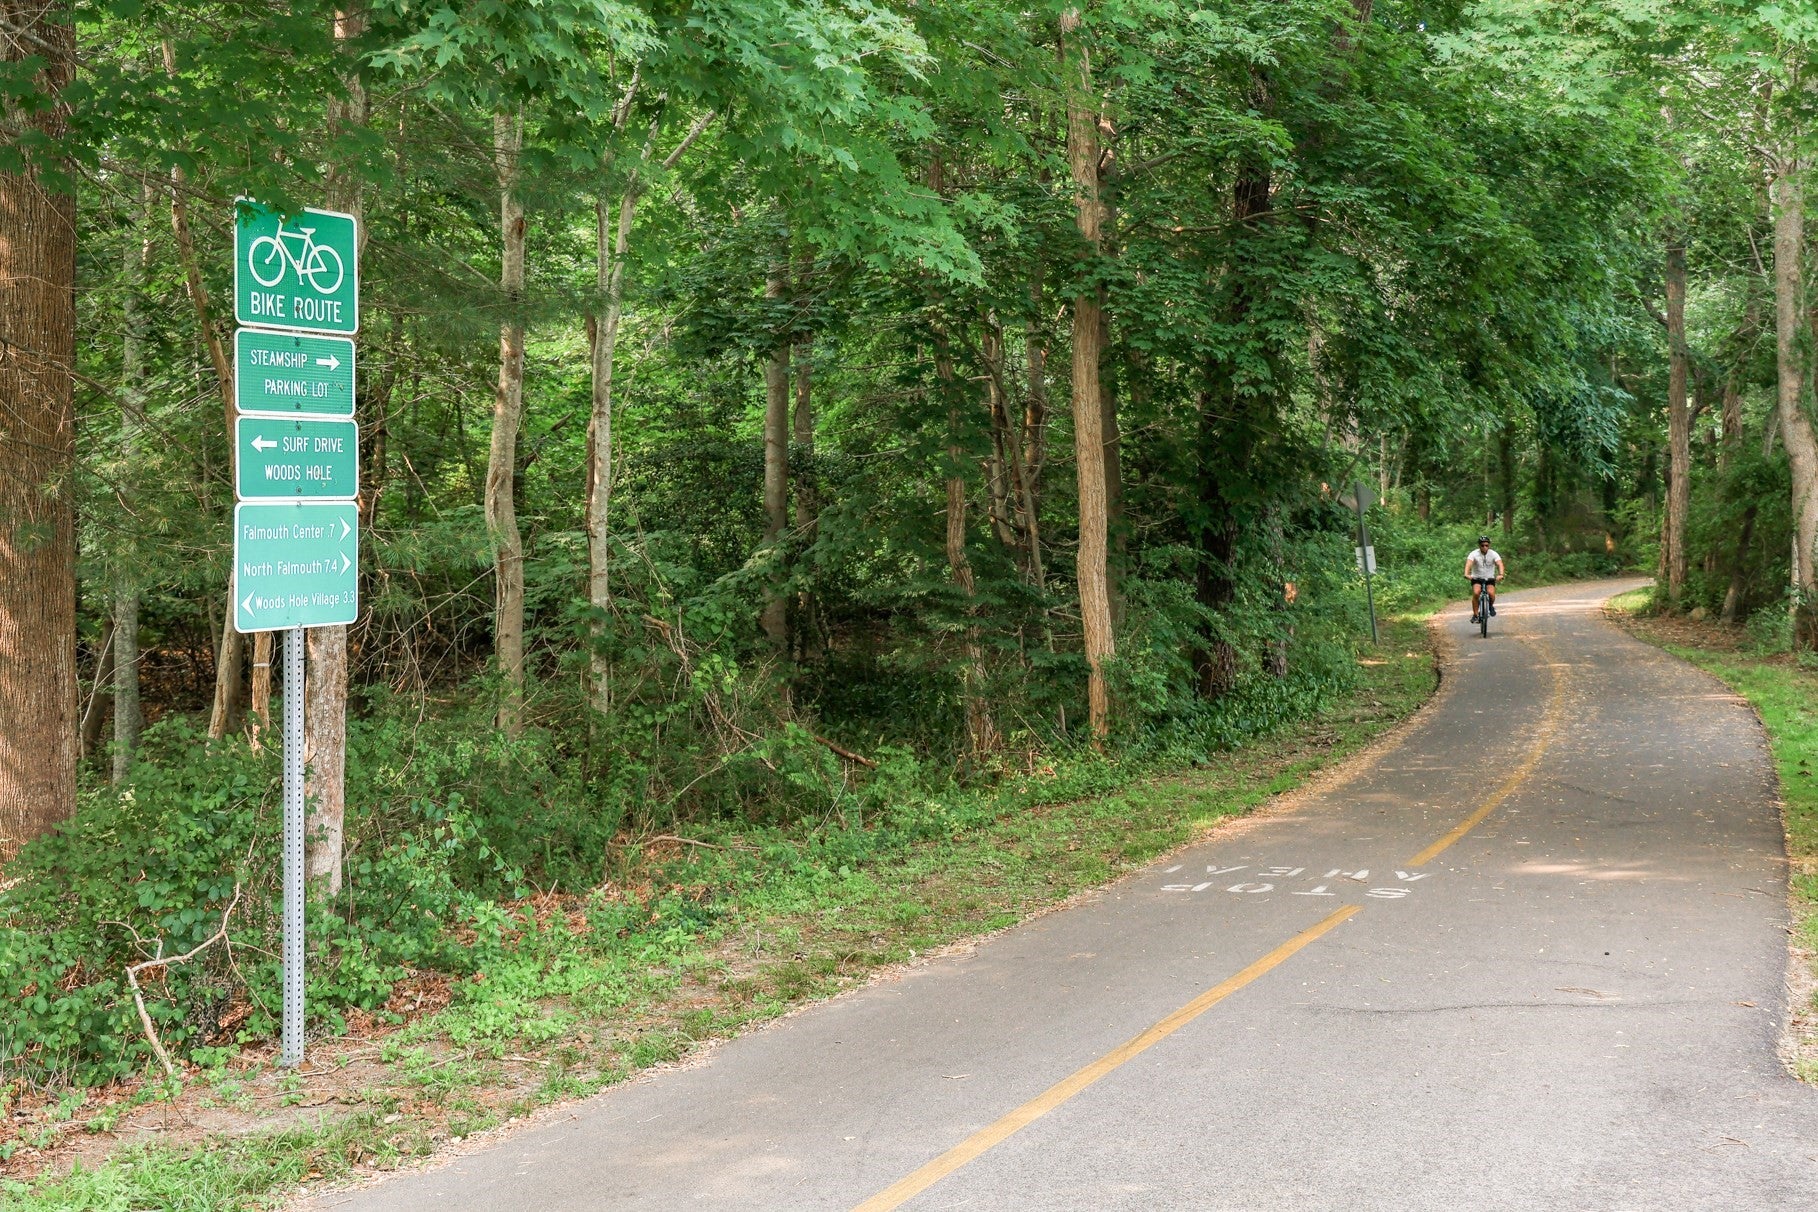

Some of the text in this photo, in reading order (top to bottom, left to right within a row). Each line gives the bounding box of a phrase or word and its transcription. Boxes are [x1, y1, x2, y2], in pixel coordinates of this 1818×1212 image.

[251, 291, 342, 323] BIKE ROUTE
[250, 350, 308, 368] STEAMSHIP
[264, 379, 328, 398] PARKING LOT
[283, 437, 344, 453] SURF DRIVE
[264, 465, 332, 481] WOODS HOLE
[243, 523, 335, 540] Falmouth Center .7
[243, 559, 338, 577] North Falmouth 7.4
[255, 591, 355, 609] Woods Hole Village 3.3
[1160, 881, 1412, 898] STOP
